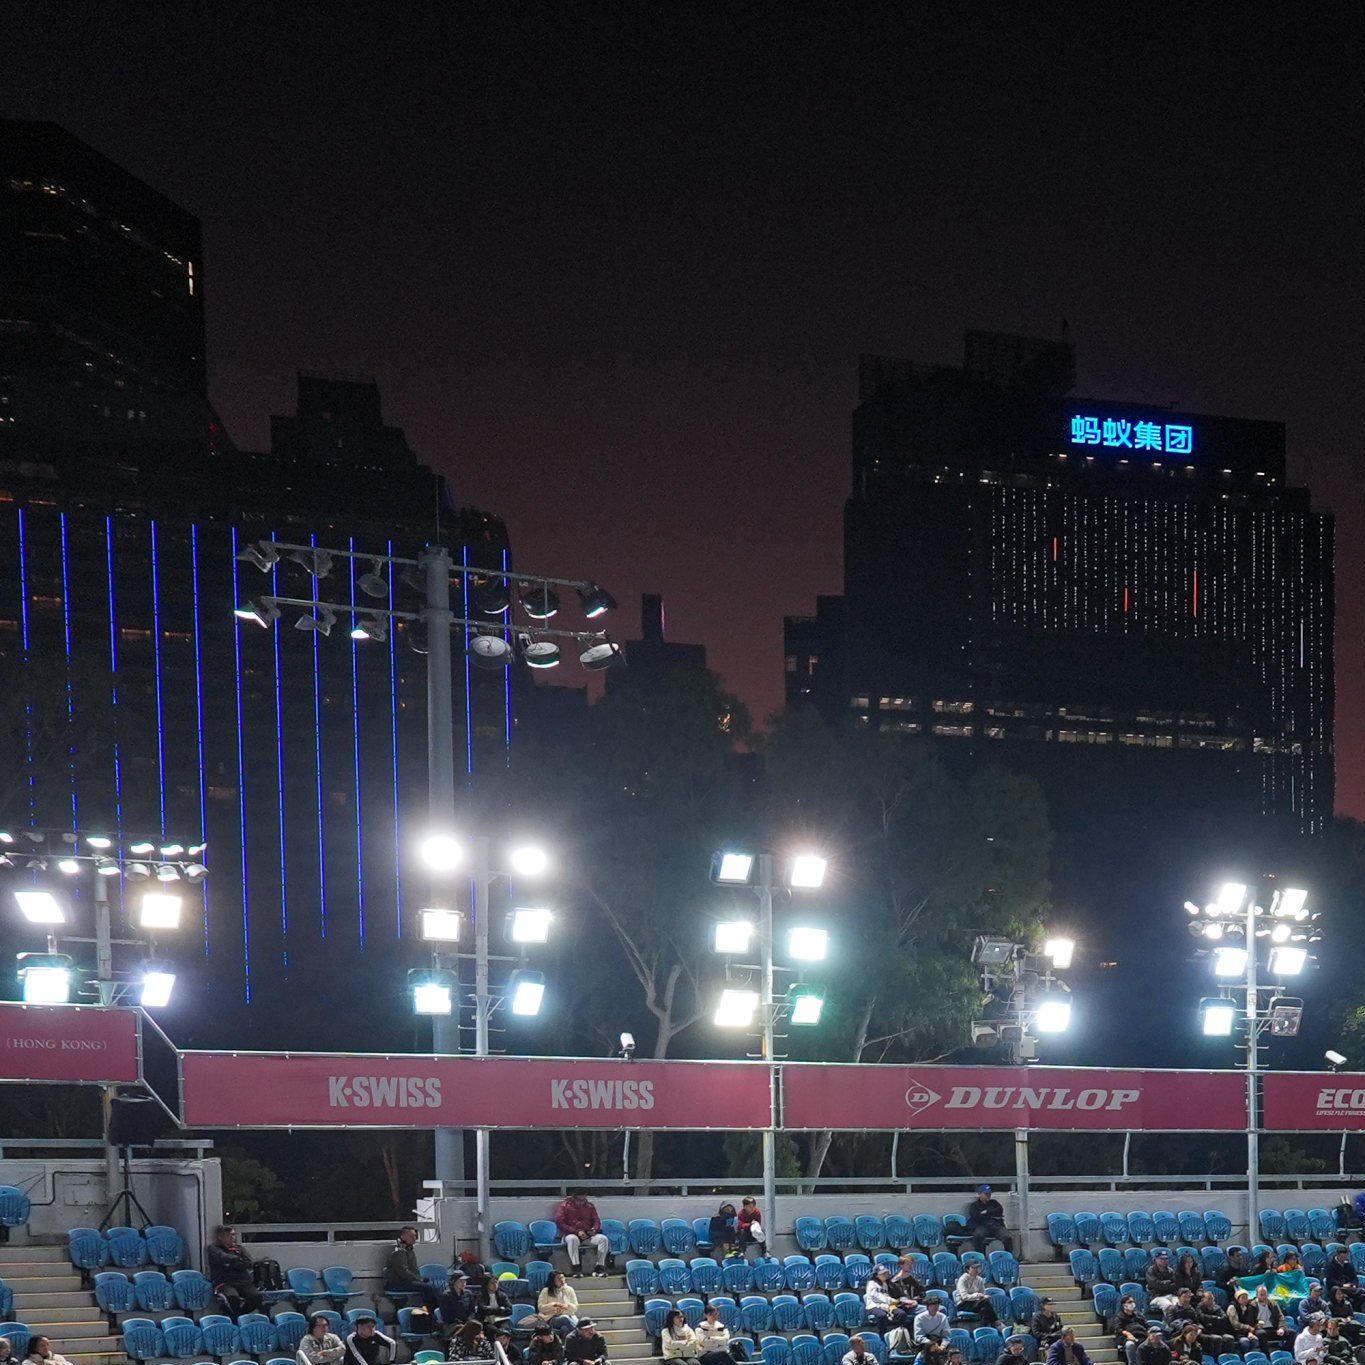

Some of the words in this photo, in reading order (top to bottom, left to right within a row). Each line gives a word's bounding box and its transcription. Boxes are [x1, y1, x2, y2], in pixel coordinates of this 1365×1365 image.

[1071, 414, 1193, 454] 蚂蚁集团
[944, 1087, 1140, 1111] DUNLOP
